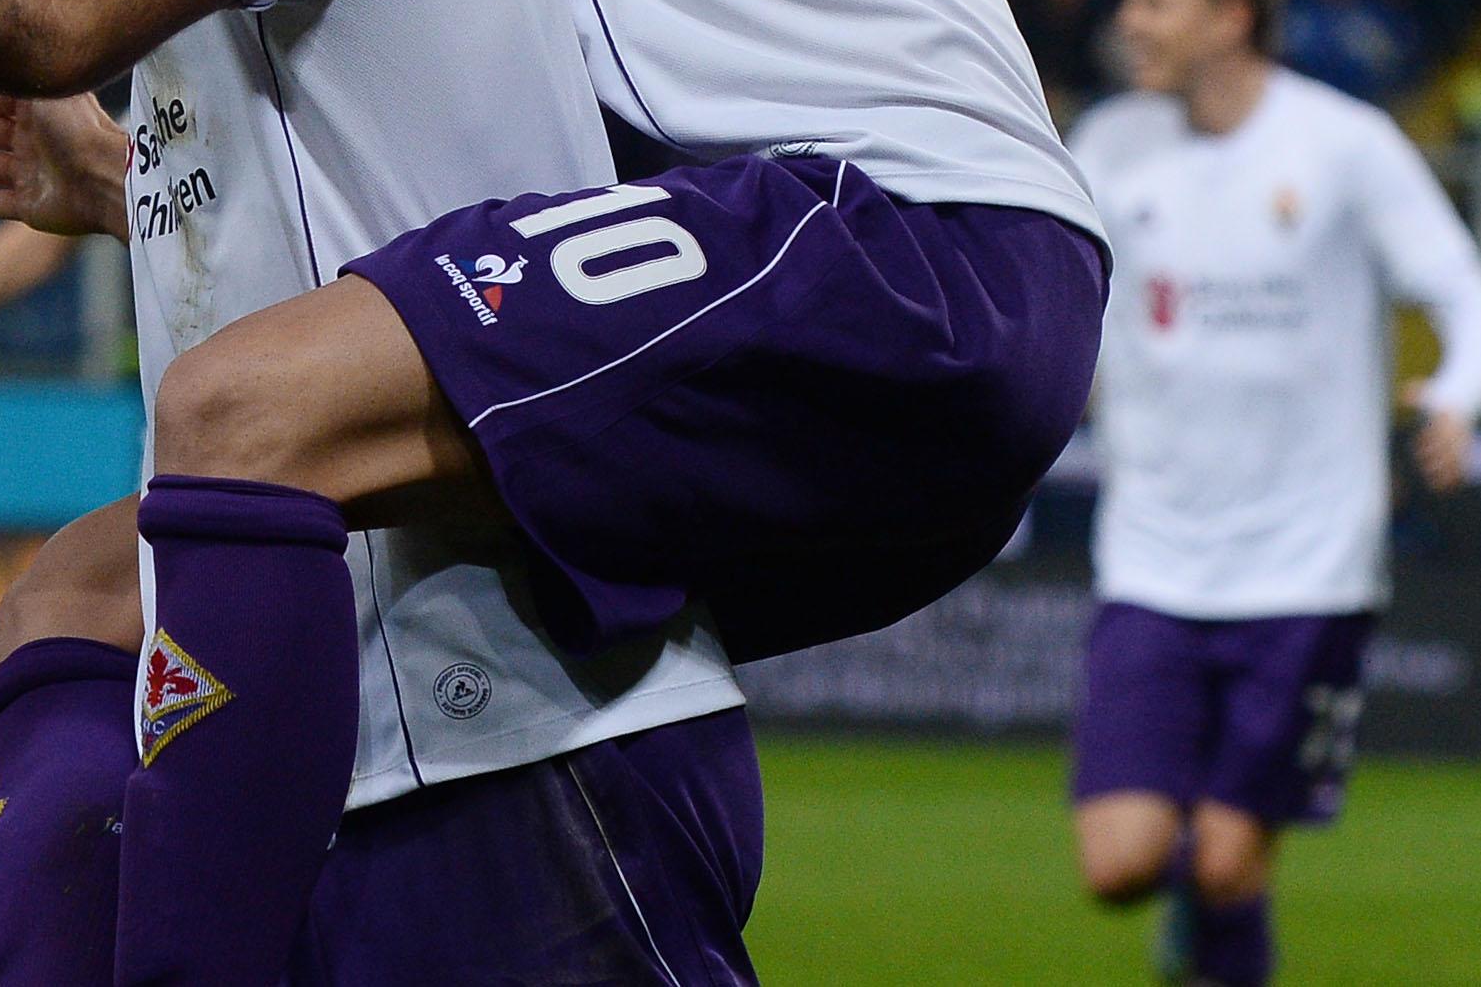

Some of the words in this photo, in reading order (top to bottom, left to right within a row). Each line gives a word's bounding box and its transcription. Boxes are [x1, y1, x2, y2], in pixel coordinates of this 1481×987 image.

[508, 184, 708, 305] 10
[442, 263, 467, 286] coq
[458, 282, 498, 326] sportif
